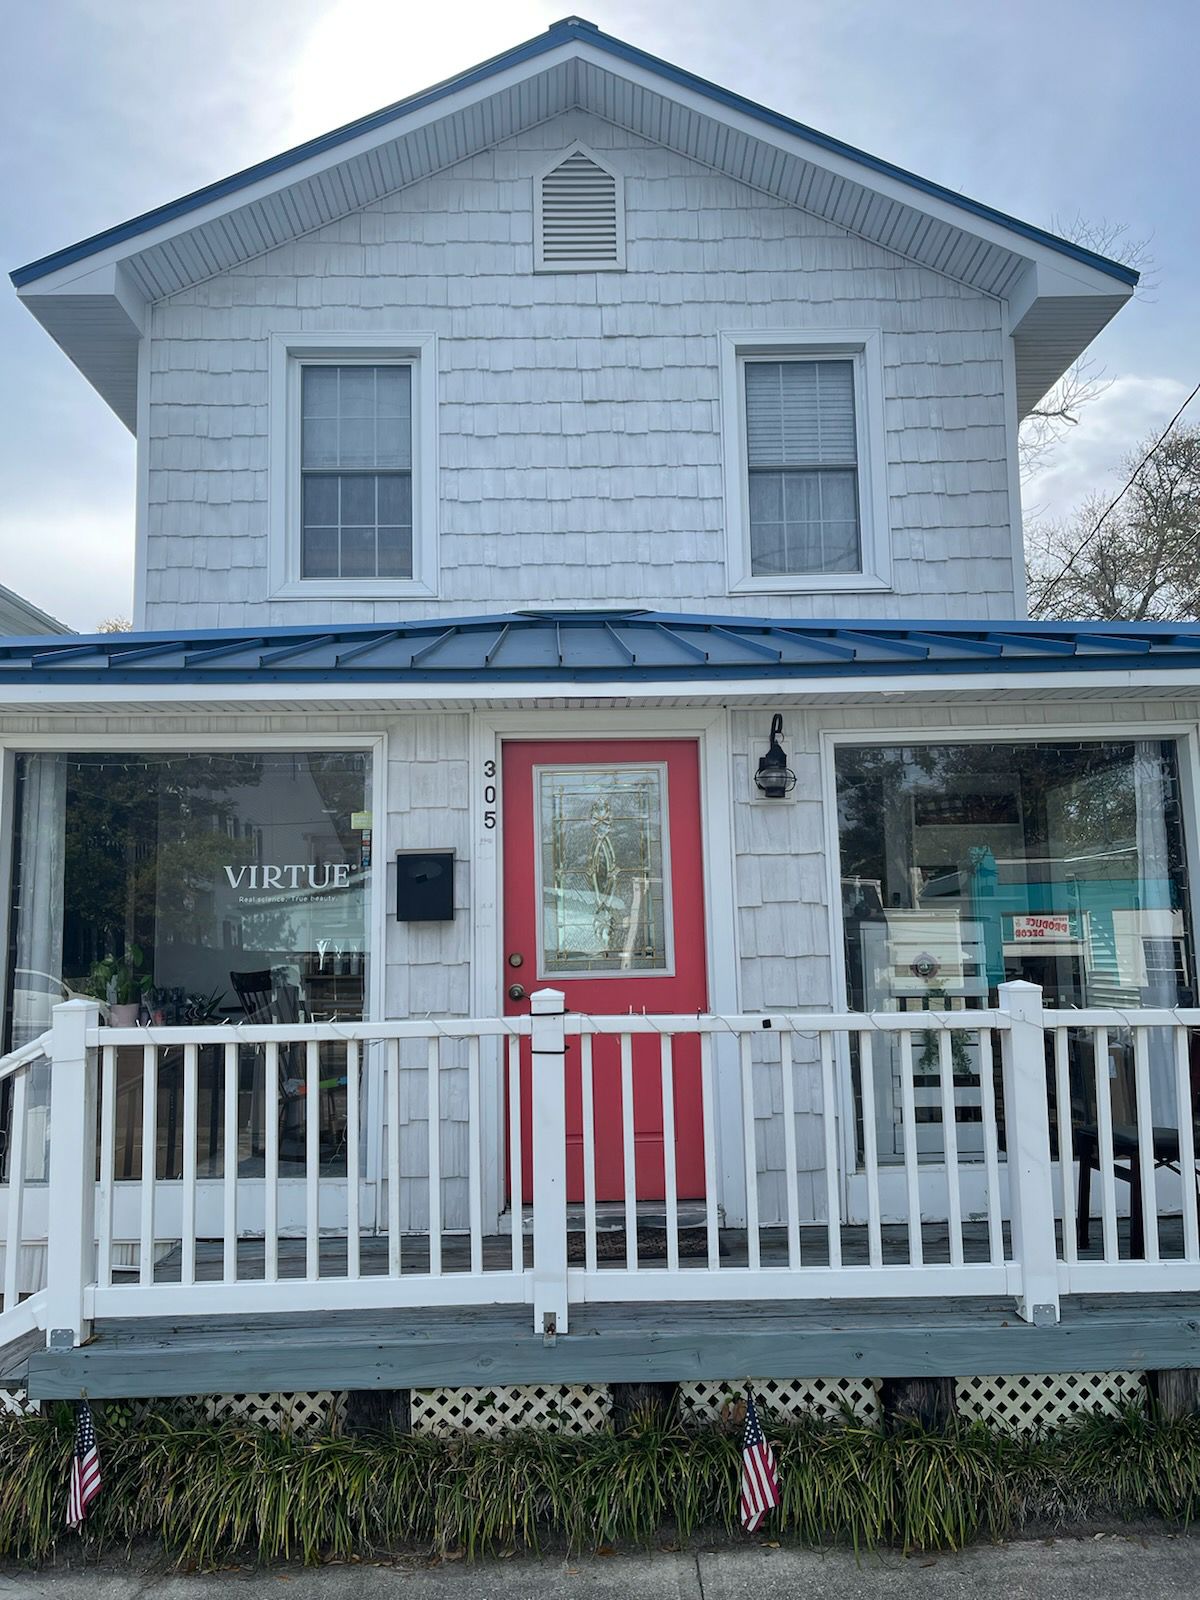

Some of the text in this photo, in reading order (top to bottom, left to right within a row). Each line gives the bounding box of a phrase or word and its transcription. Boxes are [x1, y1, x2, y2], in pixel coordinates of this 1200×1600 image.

[484, 760, 496, 829] 305
[223, 864, 350, 889] VIRTUE
[238, 895, 256, 903] Real
